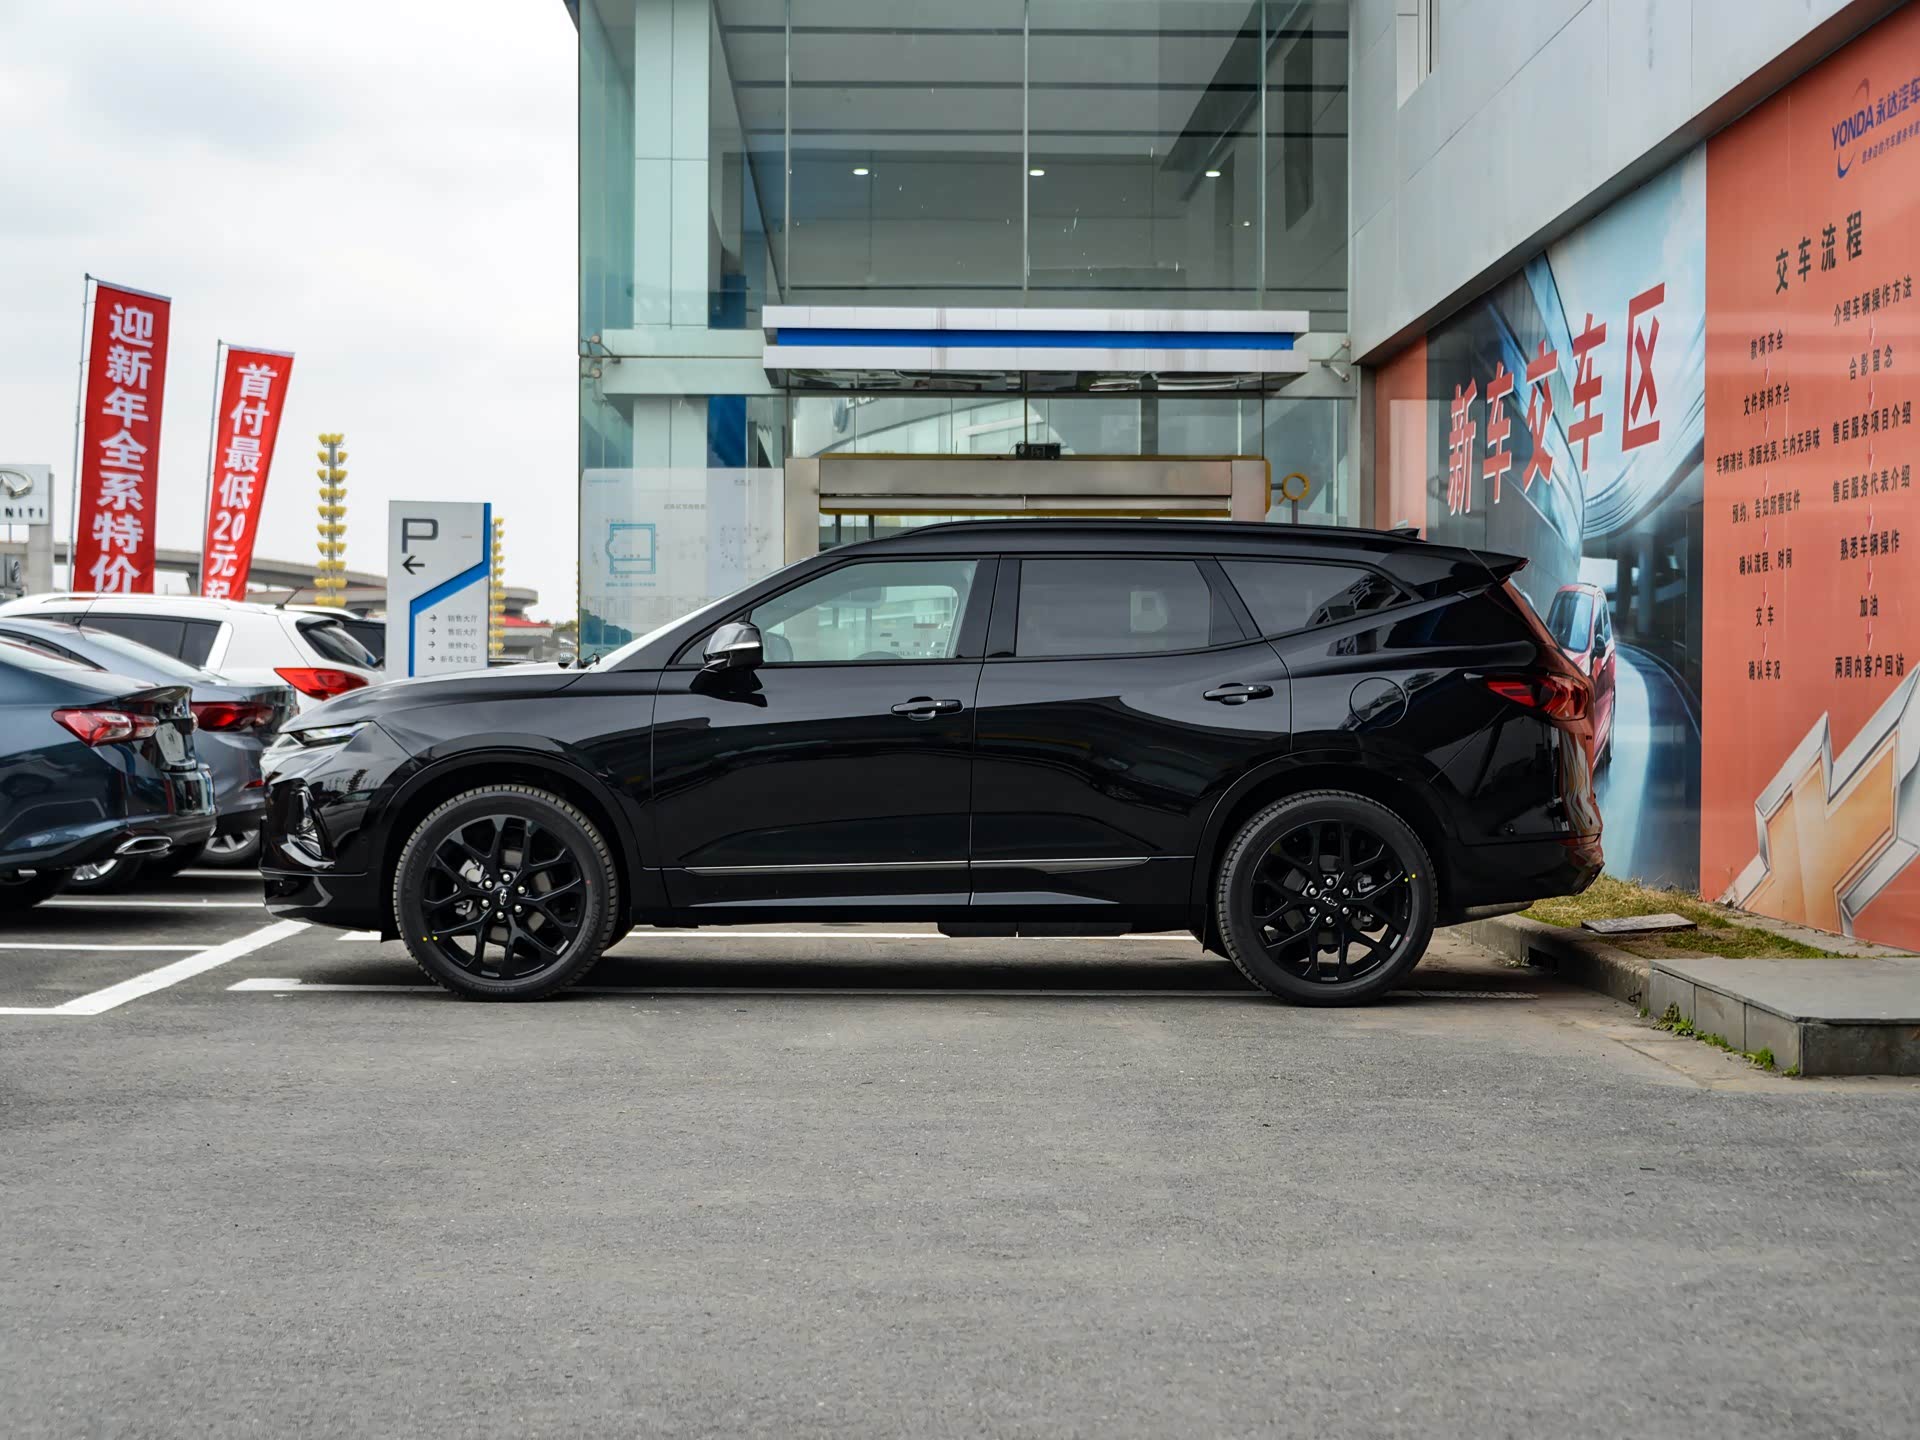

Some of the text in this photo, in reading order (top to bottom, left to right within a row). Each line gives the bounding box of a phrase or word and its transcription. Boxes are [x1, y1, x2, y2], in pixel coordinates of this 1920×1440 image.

[1832, 77, 1920, 150] YONDA 永达汽车
[1776, 210, 1862, 295] 交车流程
[1834, 274, 1912, 327] 介绍车辆操作方法
[1750, 329, 1784, 360] 款项齐全
[1849, 344, 1893, 381] 合影留念
[1447, 282, 1666, 517] 新车交车区
[1833, 401, 1911, 444] 售后服务项目介绍
[89, 303, 154, 595] 迎新年全系特价
[1833, 464, 1911, 503] 售后服务代表介绍
[402, 518, 439, 554] P
[1840, 529, 1900, 561] 熟悉车辆操作
[1756, 605, 1774, 627] 交车
[1860, 594, 1879, 617] 加油
[1748, 660, 1781, 680] 确认车况
[1835, 653, 1905, 679] 两周内客户回访
